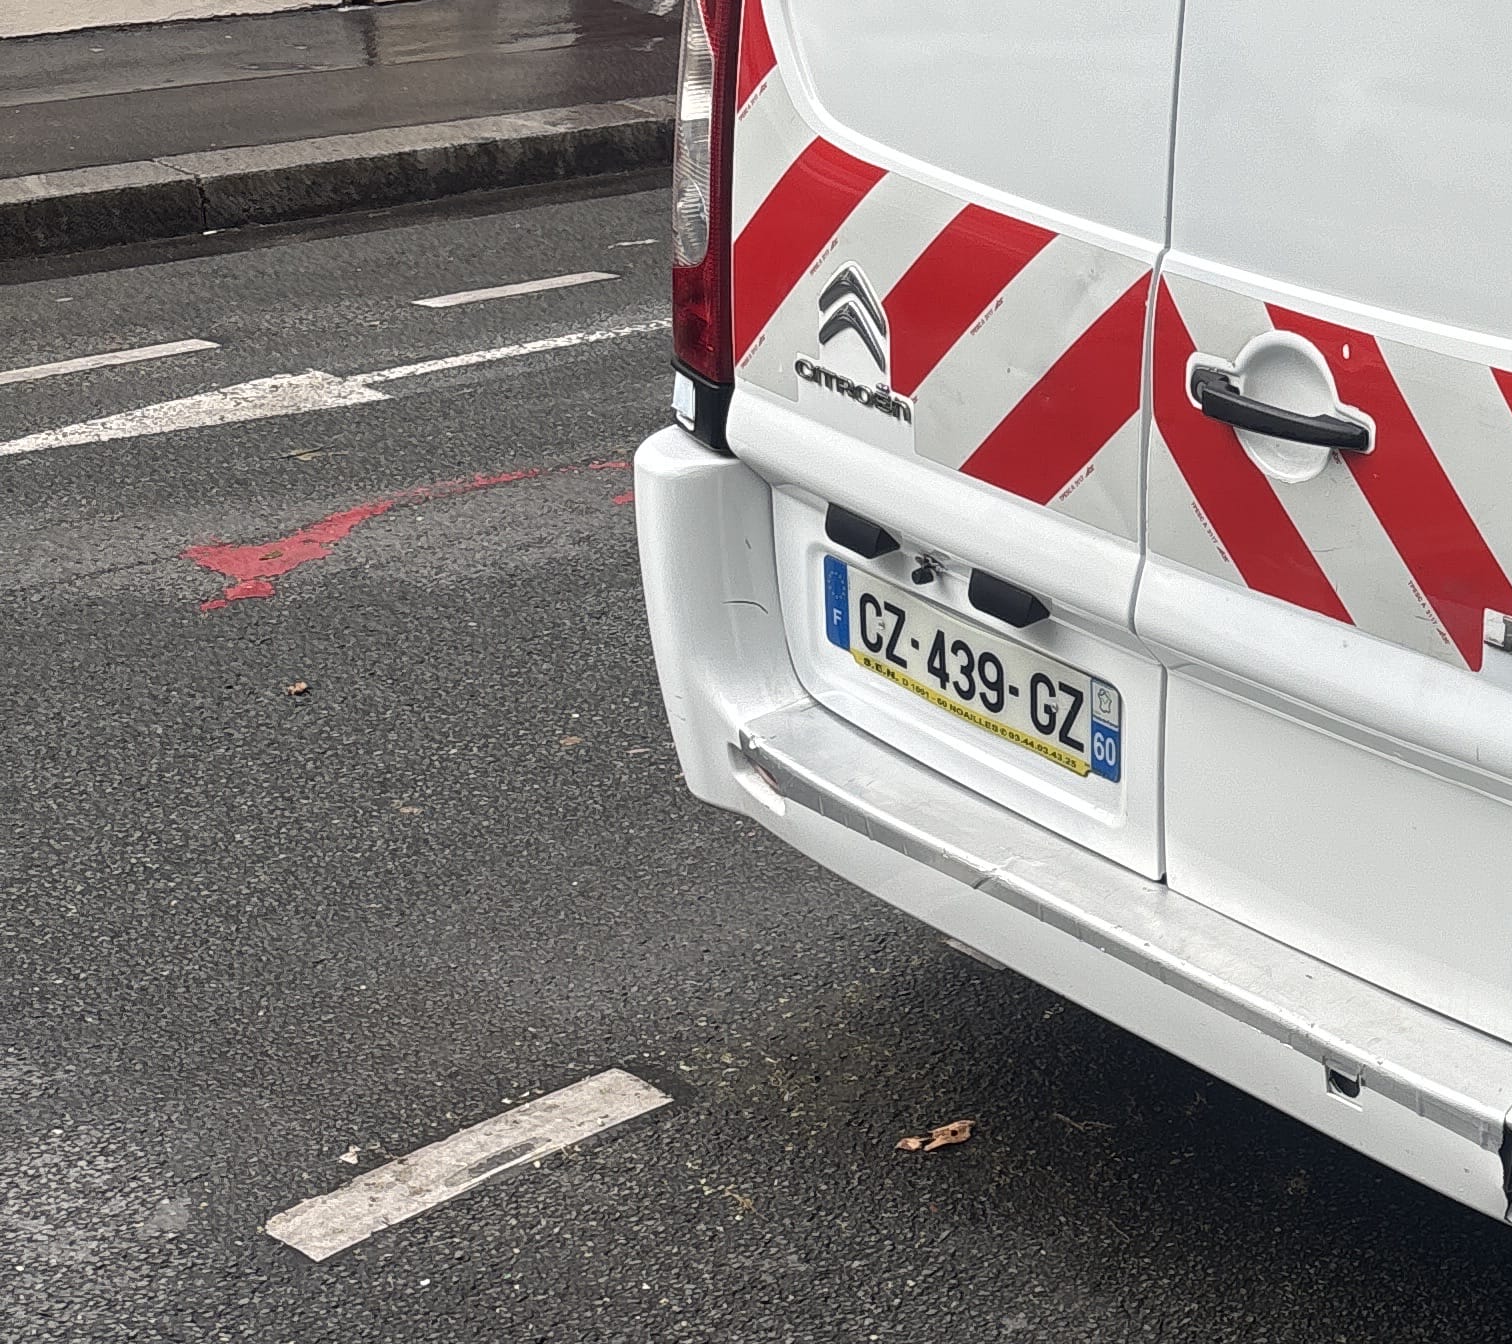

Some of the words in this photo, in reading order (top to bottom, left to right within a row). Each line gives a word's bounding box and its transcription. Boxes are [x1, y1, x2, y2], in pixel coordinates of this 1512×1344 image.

[832, 607, 843, 626] F
[859, 592, 1084, 754] CZ-439-GZ
[950, 703, 999, 733] NOAILLES
[1093, 731, 1117, 767] 60
